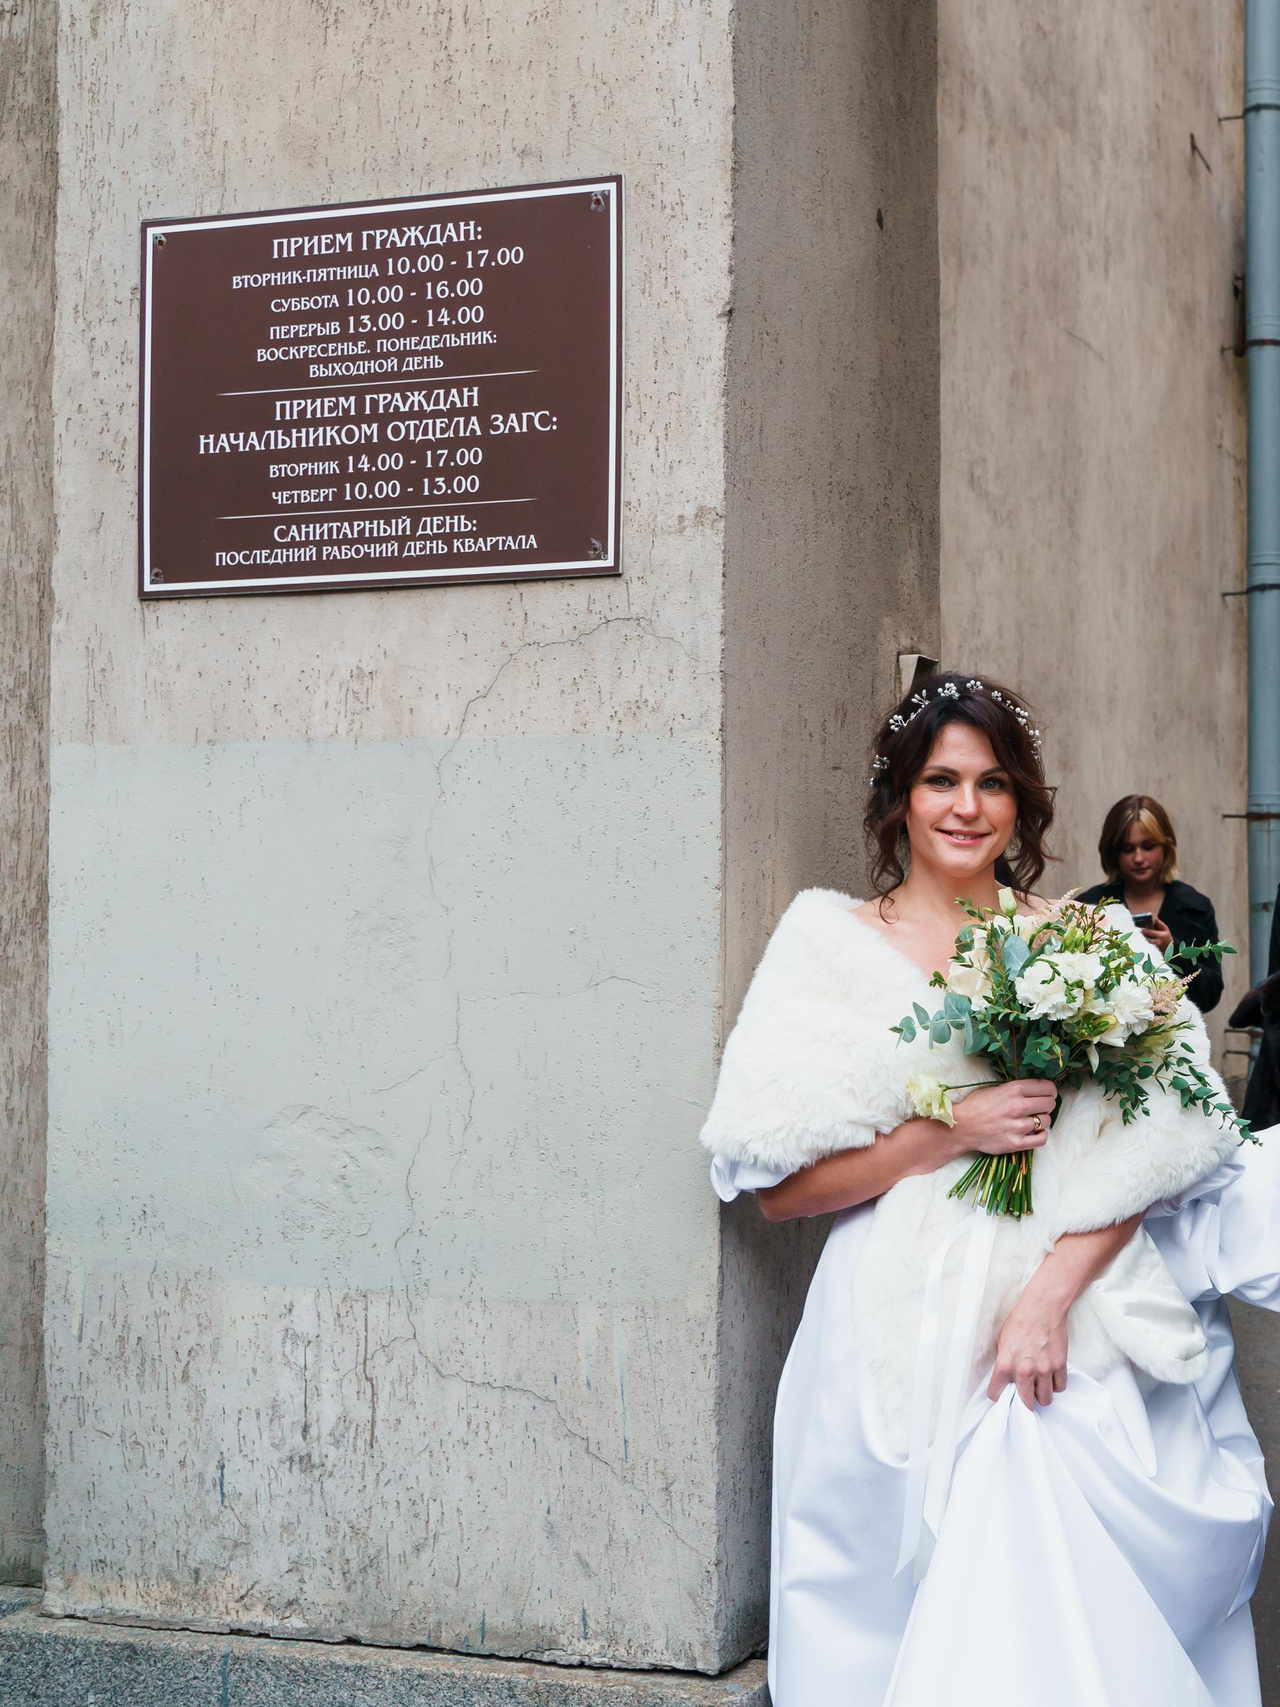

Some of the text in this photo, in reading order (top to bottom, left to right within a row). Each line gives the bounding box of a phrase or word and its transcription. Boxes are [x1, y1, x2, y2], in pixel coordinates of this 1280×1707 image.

[273, 221, 481, 258] ПРИЕМ ГРАЖДАН:
[233, 264, 379, 289] ВТОРНИК-ПЯТНИЦА
[388, 254, 443, 275] 10.00
[467, 247, 524, 268] 17.00
[271, 295, 339, 312] СУББОТА
[348, 285, 403, 306] 10.00
[426, 278, 483, 299] 16.00
[270, 322, 340, 339] ПЕРЕРЫВ
[349, 312, 404, 333] 13.00
[427, 306, 484, 326] 14.00
[377, 331, 496, 352] ПОНЕДЕЛЬНИК:
[310, 355, 443, 377] ВЫХОДНОЙ ДЕНЬ
[275, 387, 478, 420] ПРИЕМ ГРАЖДАН
[199, 411, 557, 454] НАЧАЛЬНИКОМ ОТДЕЛА ЗАГС:
[270, 461, 340, 477] ВТОРНИК
[348, 453, 403, 472] 14.00
[426, 447, 482, 467] 17.00
[272, 488, 337, 504] ЧЕТВЕРГ
[345, 480, 400, 500] 10.00
[423, 475, 479, 495] 13.00
[274, 515, 476, 542] САНИТАРНЫЙ ДЕНЬ:
[216, 535, 537, 566] ПОСЛЕДНИЙ РАБОЧИЙ ДЕНЬ КВАРТАЛА
